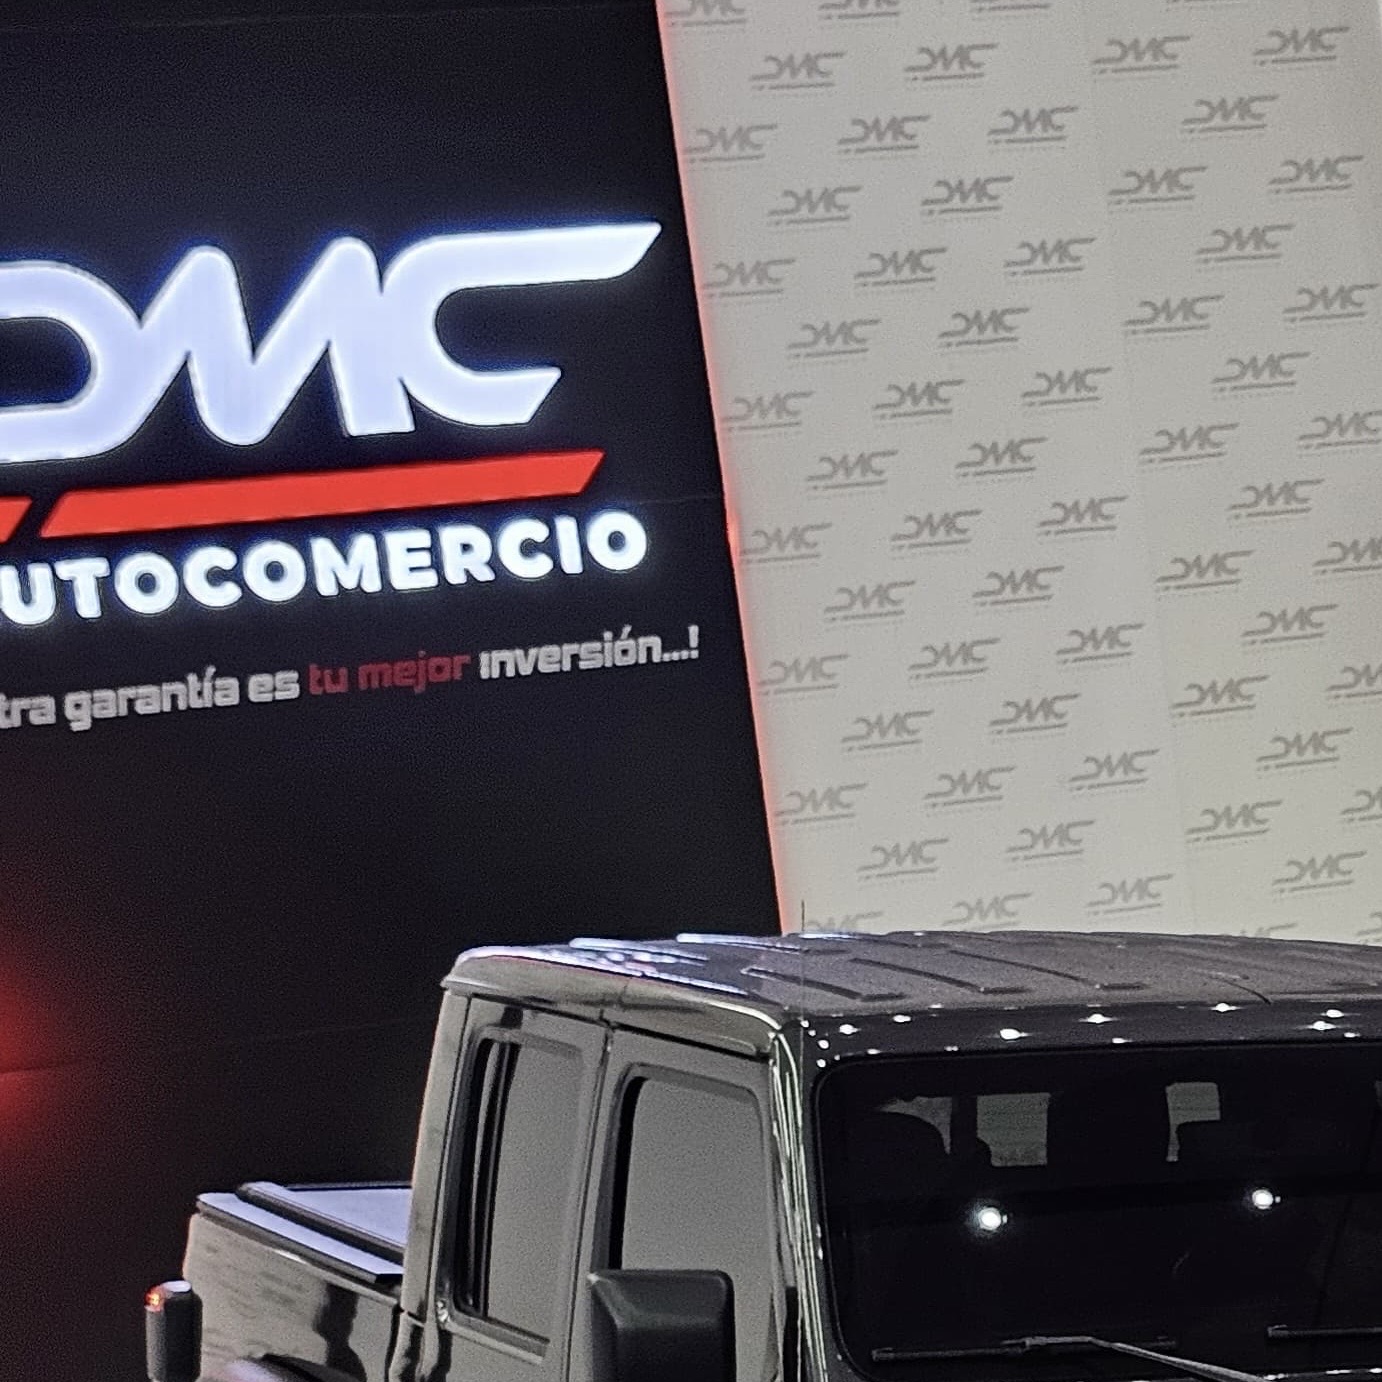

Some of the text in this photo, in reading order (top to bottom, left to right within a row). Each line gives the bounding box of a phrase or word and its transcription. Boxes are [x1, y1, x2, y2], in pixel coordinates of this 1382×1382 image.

[903, 42, 998, 73] DMC
[1091, 34, 1191, 66] DMC
[1252, 25, 1351, 57] DMC
[987, 105, 1079, 136] DMC
[1181, 94, 1279, 125] DMC
[837, 114, 931, 146] DMC
[1107, 165, 1208, 197] DMC
[1268, 154, 1365, 186] DMC
[920, 175, 1014, 207] DMC
[1003, 236, 1097, 268] DMC
[1195, 223, 1295, 255] DMC
[853, 246, 948, 280] DMC
[1123, 294, 1225, 327] DMC
[1283, 282, 1380, 314] DMC
[787, 318, 882, 350] DMC
[937, 306, 1031, 339] DMC
[1020, 366, 1113, 399] DMC
[1211, 351, 1311, 384] DMC
[872, 378, 966, 411] DMC
[954, 436, 1048, 470] DMC
[1139, 422, 1240, 456] DMC
[805, 449, 899, 482] DMC
[1037, 495, 1128, 528] DMC
[1227, 478, 1325, 511] DMC
[890, 508, 983, 542] DMC
[971, 564, 1065, 599] DMC
[1155, 549, 1254, 584] DMC
[824, 579, 917, 613] DMC
[1241, 603, 1339, 638] DMC
[908, 637, 1001, 671] DMC
[1055, 622, 1145, 656] DMC
[64, 665, 240, 732] garantía
[248, 670, 300, 703] es
[309, 663, 349, 695] tu
[358, 651, 471, 693] mejor
[1169, 674, 1270, 710] DMC
[840, 709, 934, 744] DMC
[989, 692, 1082, 727] DMC
[1256, 727, 1353, 763] DMC
[923, 765, 1016, 800] DMC
[1068, 748, 1160, 783] DMC
[1185, 799, 1283, 835] DMC
[1006, 819, 1096, 853] DMC
[858, 837, 950, 872] DMC
[1272, 850, 1367, 886] DMC
[1087, 873, 1174, 907] DMC
[942, 892, 1033, 927] DMC
